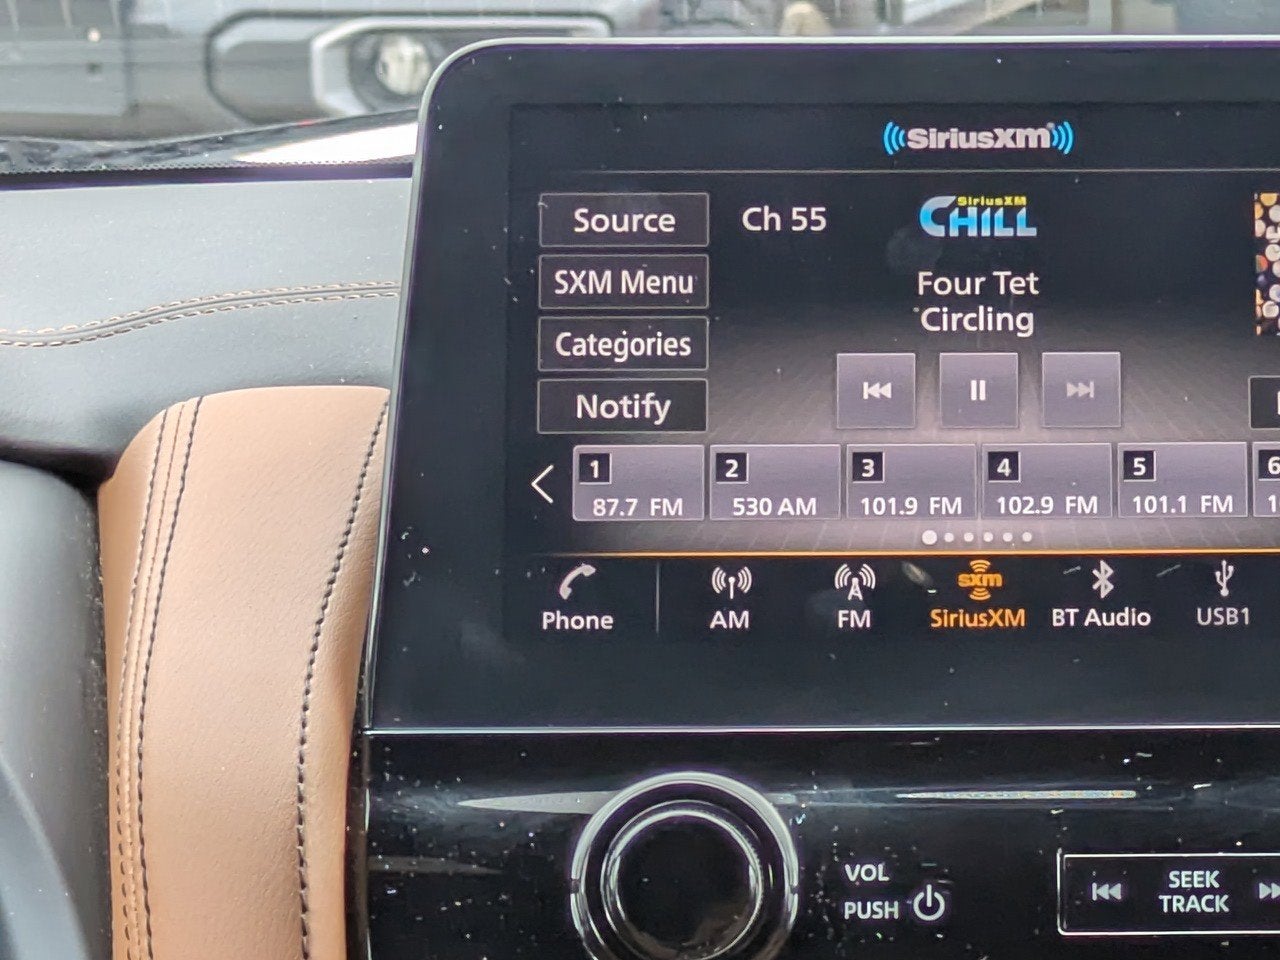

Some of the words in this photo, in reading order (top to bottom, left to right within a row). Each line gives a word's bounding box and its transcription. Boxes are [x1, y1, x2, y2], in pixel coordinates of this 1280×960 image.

[573, 208, 677, 234] Source
[741, 205, 782, 232] Ch
[791, 206, 828, 232] 55
[919, 195, 1038, 238] CHILL
[553, 269, 614, 295] SXM
[621, 269, 695, 295] Menu
[917, 271, 985, 296] Four
[993, 271, 1040, 296] Tet
[919, 306, 1035, 338] Circling
[554, 331, 693, 363] Categories
[576, 393, 672, 426] Notify
[589, 459, 600, 478] 1
[725, 459, 739, 478] 2
[861, 459, 876, 478] 3
[996, 457, 1012, 477] 4
[1132, 457, 1147, 475] 5
[592, 498, 638, 517] 87.7
[650, 498, 684, 517] FM
[732, 498, 772, 517] 530
[777, 498, 817, 516] AM
[860, 497, 918, 516] 101.9
[929, 497, 963, 516] FM
[997, 496, 1054, 515] 102.9
[1065, 496, 1099, 515] FM
[1132, 495, 1187, 514] 101.1
[1200, 495, 1234, 514] FM
[541, 610, 614, 631] Phone
[709, 609, 751, 629] AM
[837, 609, 872, 628] FM
[930, 607, 1026, 629] SiriusXM
[1051, 608, 1079, 627] BT
[1083, 606, 1152, 627] Audio
[1197, 606, 1250, 626] USB1
[844, 863, 890, 882] VOL
[1168, 870, 1220, 889] SEEK
[844, 901, 899, 920] PUSH
[1158, 894, 1229, 914] TRACK
